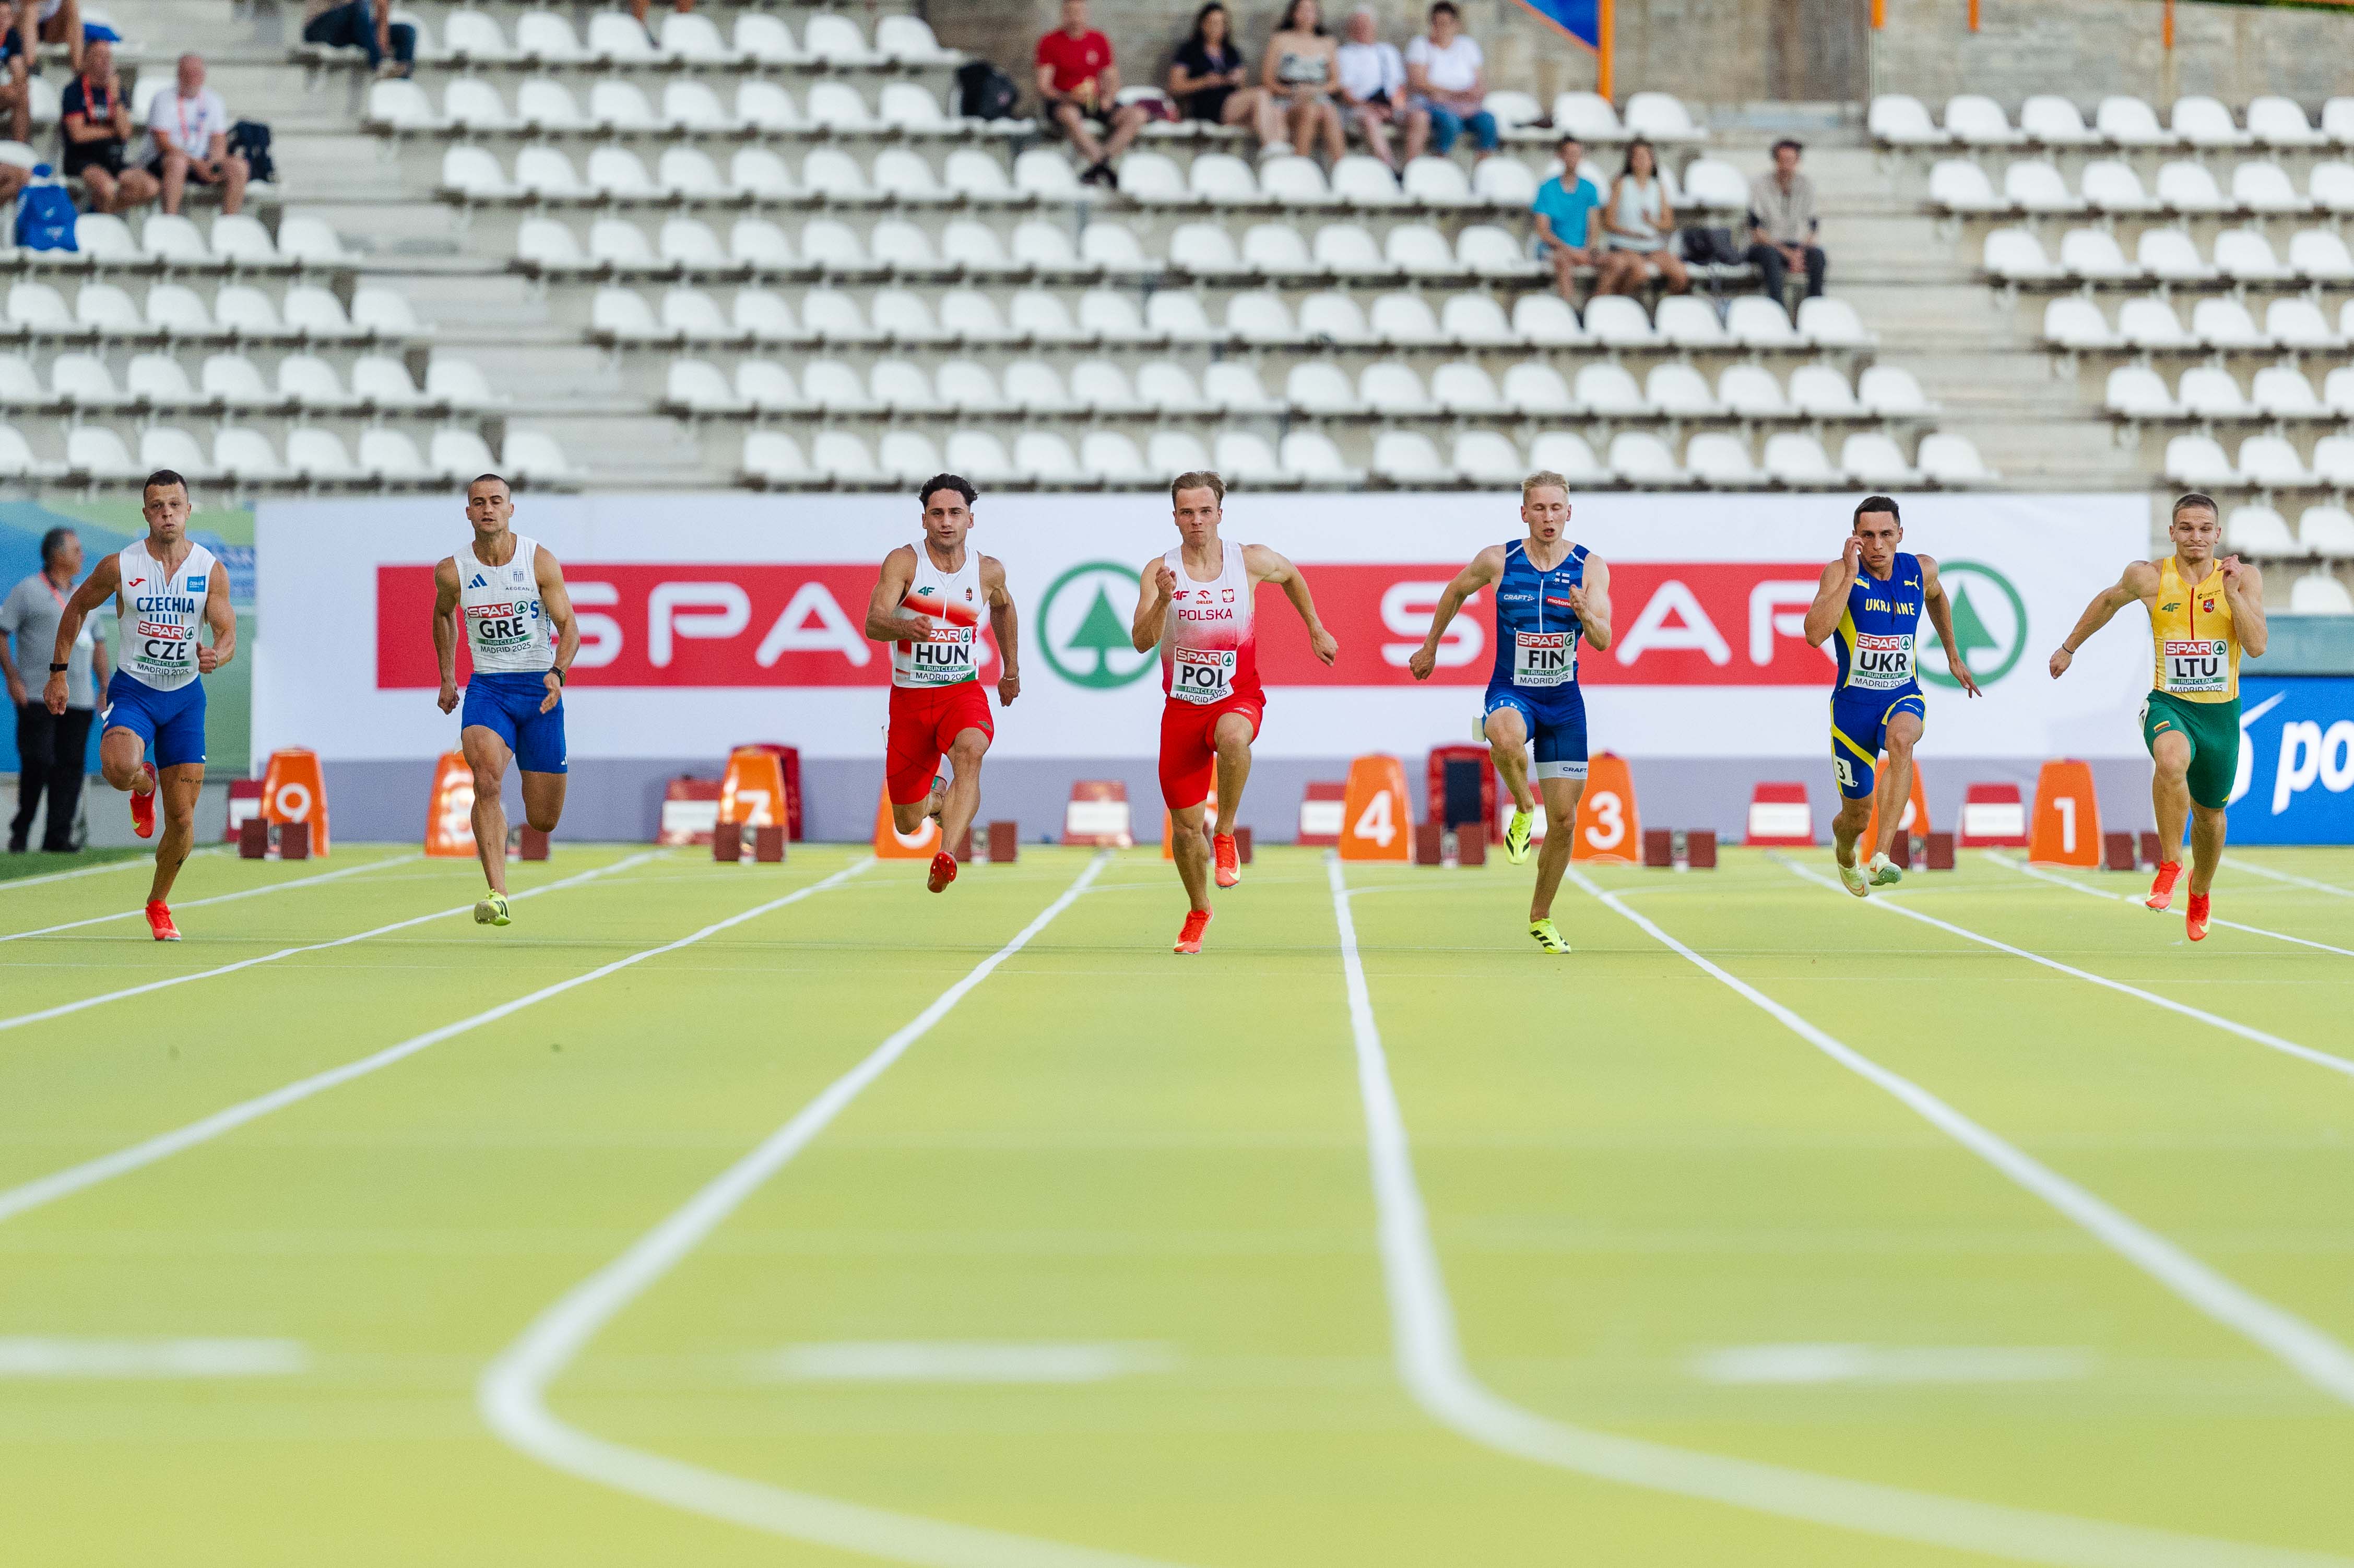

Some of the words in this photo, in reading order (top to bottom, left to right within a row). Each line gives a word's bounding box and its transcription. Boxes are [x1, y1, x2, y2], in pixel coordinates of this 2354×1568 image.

[136, 597, 195, 613] CZECHIA
[467, 604, 513, 617] SPAR
[1178, 609, 1233, 621] POLSKA
[139, 622, 183, 638] SPAR
[479, 616, 526, 639] GRE
[930, 630, 960, 641] PAR
[480, 645, 511, 654] MADRID
[512, 642, 531, 652] 2025
[1518, 634, 1563, 647] SPAR
[1858, 636, 1899, 649] SPAR
[145, 639, 187, 660] CZE
[916, 644, 969, 664] HUN
[1177, 649, 1220, 664] SPAR
[2166, 643, 2210, 655] SPAR
[1528, 649, 1566, 669] FIN
[1860, 651, 1908, 672] UKR
[137, 663, 170, 675] MADRID
[1181, 664, 1227, 688] POL
[2175, 658, 2218, 678] LTU
[916, 672, 950, 681] MADRID
[1855, 677, 1889, 688] MADRID
[1176, 693, 1209, 703] MADRID
[1837, 761, 1846, 780] 3
[276, 782, 311, 824] 9
[1353, 790, 1397, 847] 4
[1584, 791, 1626, 850] 3
[2053, 797, 2077, 853] 1
